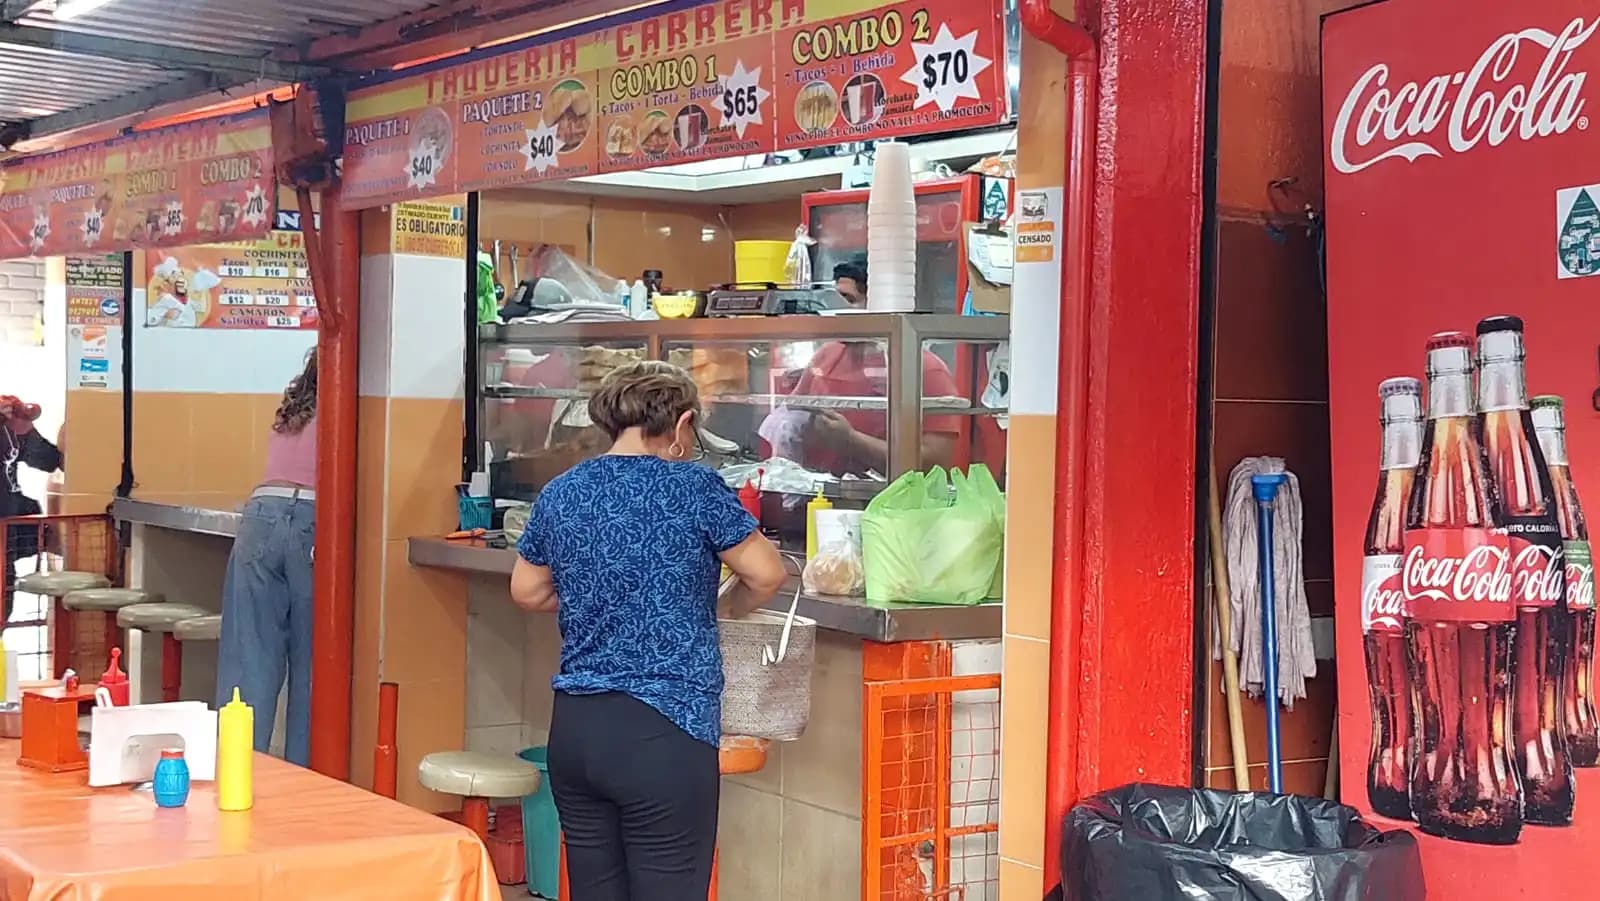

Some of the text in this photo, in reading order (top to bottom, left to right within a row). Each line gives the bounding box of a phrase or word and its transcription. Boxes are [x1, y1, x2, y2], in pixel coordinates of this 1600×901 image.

[792, 8, 931, 65] COMBO 2
[424, 39, 577, 104] TAQUERIA
[610, 55, 719, 100] COMBO 1
[795, 67, 826, 83] Tacos
[853, 52, 895, 73] Bebida
[923, 49, 969, 92] $70
[462, 90, 544, 124] PAQUETE 2
[609, 101, 636, 113] Tacos
[652, 94, 679, 107] Torta
[689, 83, 724, 101] Bebida
[723, 86, 758, 122] $65
[1331, 16, 1600, 173] Coca-Cola
[345, 118, 401, 146] PAQUETE
[842, 121, 874, 137] COMBO
[932, 103, 992, 124] PROMOCION
[530, 135, 554, 159] $40
[200, 157, 263, 186] COMBO 2
[412, 154, 433, 179] $40
[127, 168, 167, 197] COMBO
[166, 209, 182, 228] $65
[396, 217, 466, 238] ES OBLIGATORIO
[1017, 233, 1052, 245] CENSADO
[222, 259, 250, 267] Tacos
[256, 259, 289, 268] Tortas
[243, 249, 306, 261] COCHINITA
[227, 267, 245, 276] $10
[264, 268, 281, 277] $16
[222, 287, 250, 295] Tacos
[256, 287, 289, 296] Tortas
[228, 296, 245, 304] $12
[264, 297, 281, 305] $20
[1402, 544, 1512, 601] Coca-Cola
